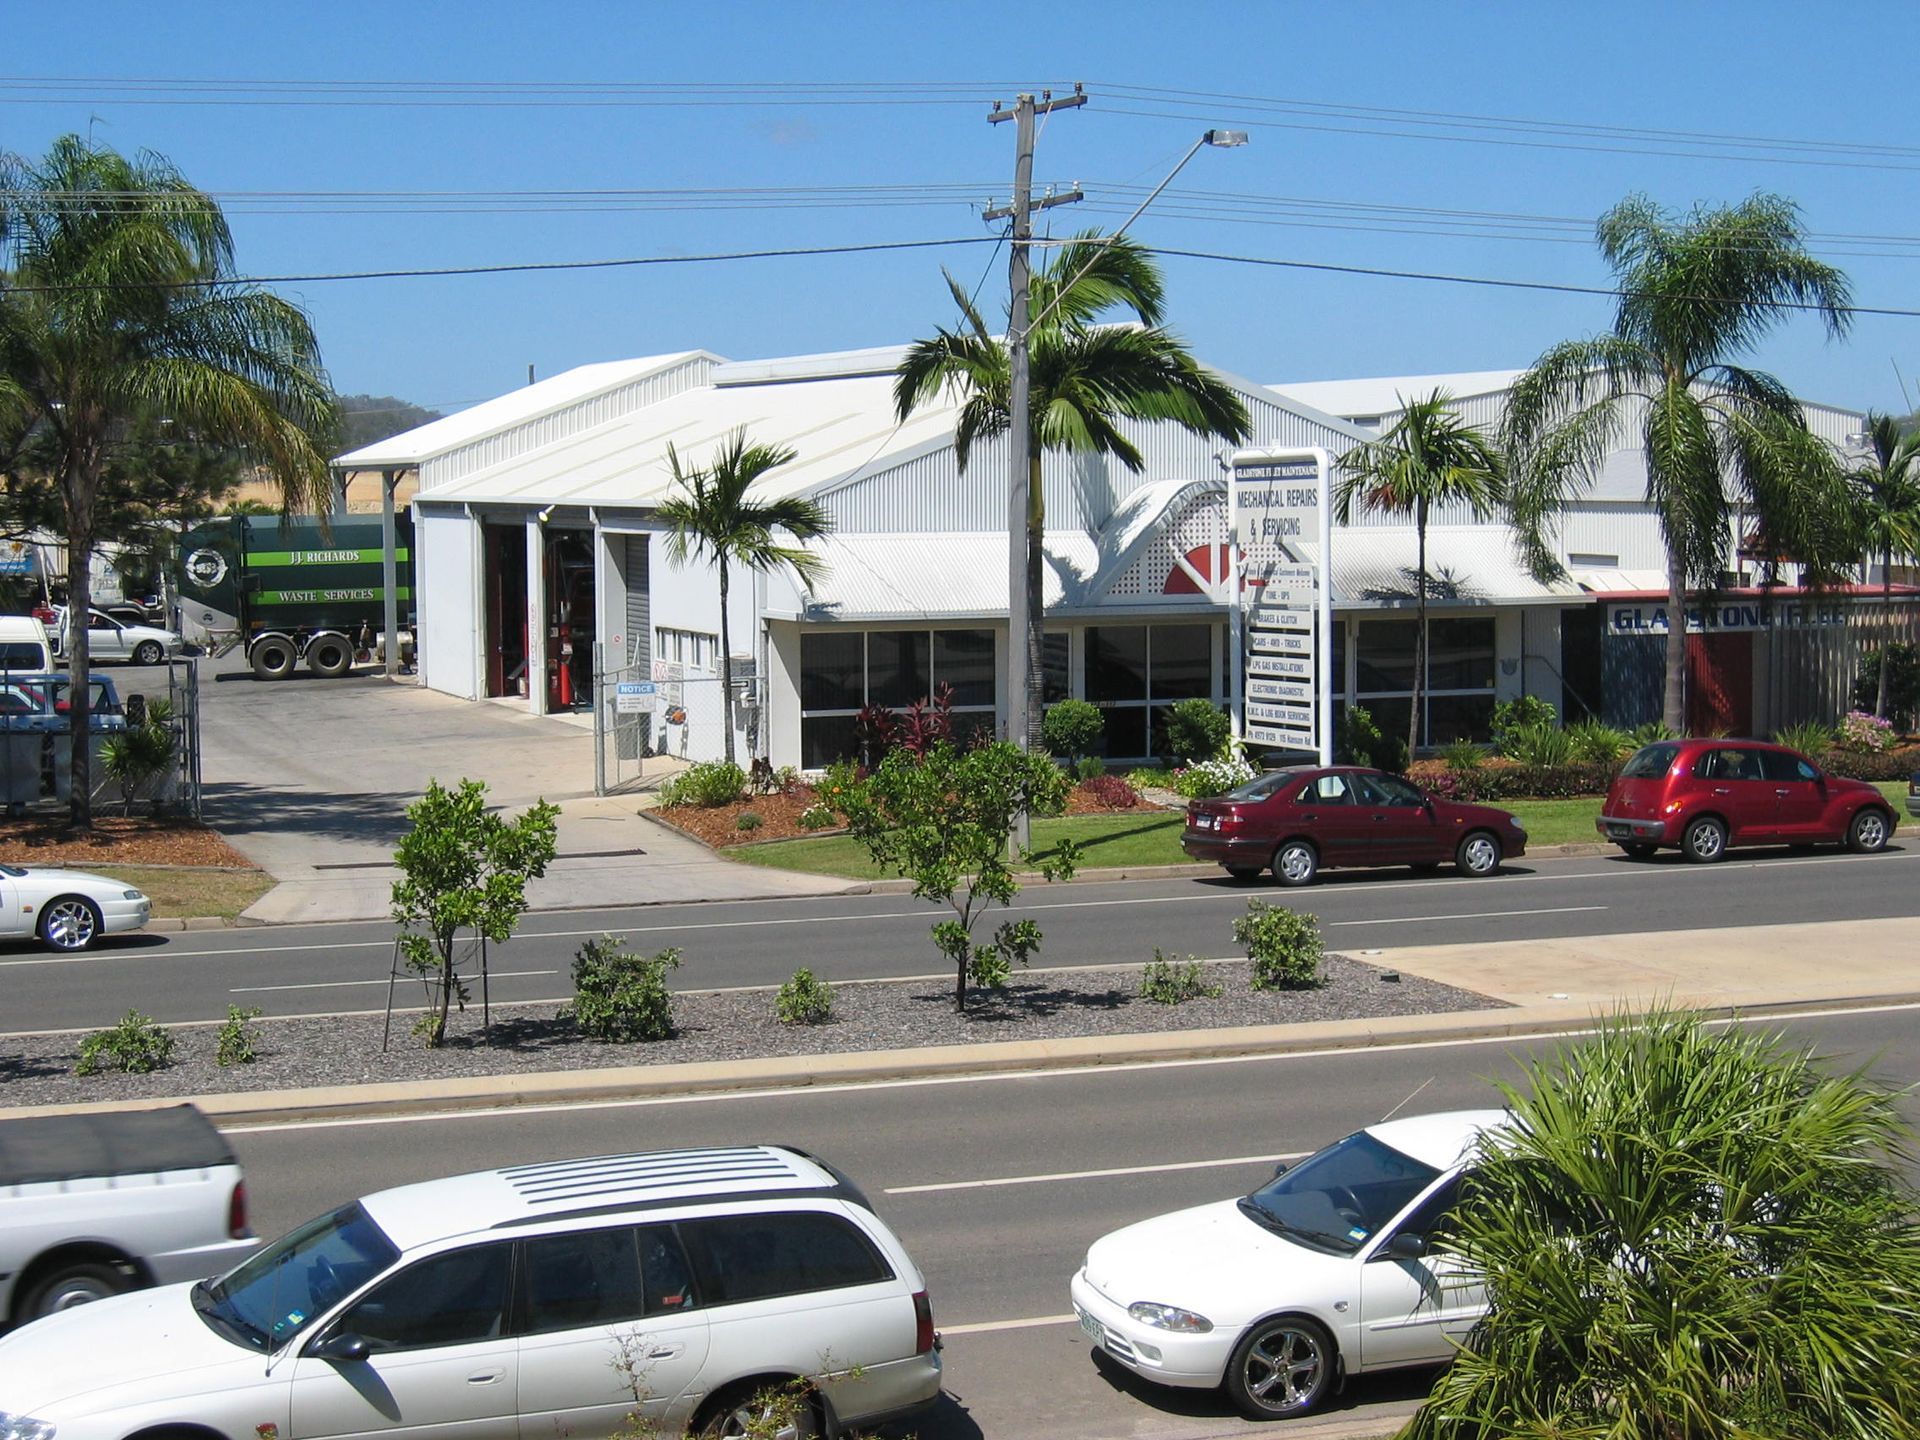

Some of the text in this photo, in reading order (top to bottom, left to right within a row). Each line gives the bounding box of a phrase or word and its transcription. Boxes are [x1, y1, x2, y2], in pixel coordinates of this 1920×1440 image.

[1265, 466, 1281, 478] FLET
[1237, 487, 1318, 508] MECHANICAL REPAIRS
[1250, 517, 1300, 536] & SERVICING
[306, 550, 360, 563] RICHARDS
[279, 588, 374, 602] WASTE SERVICES
[1257, 613, 1275, 623] BRAKES
[1280, 615, 1298, 625] CLUTCH
[1284, 639, 1302, 649] TRUCKS
[1262, 661, 1271, 671] GAS
[620, 684, 652, 694] NOTICE
[1252, 683, 1278, 695] ELECTRONIC
